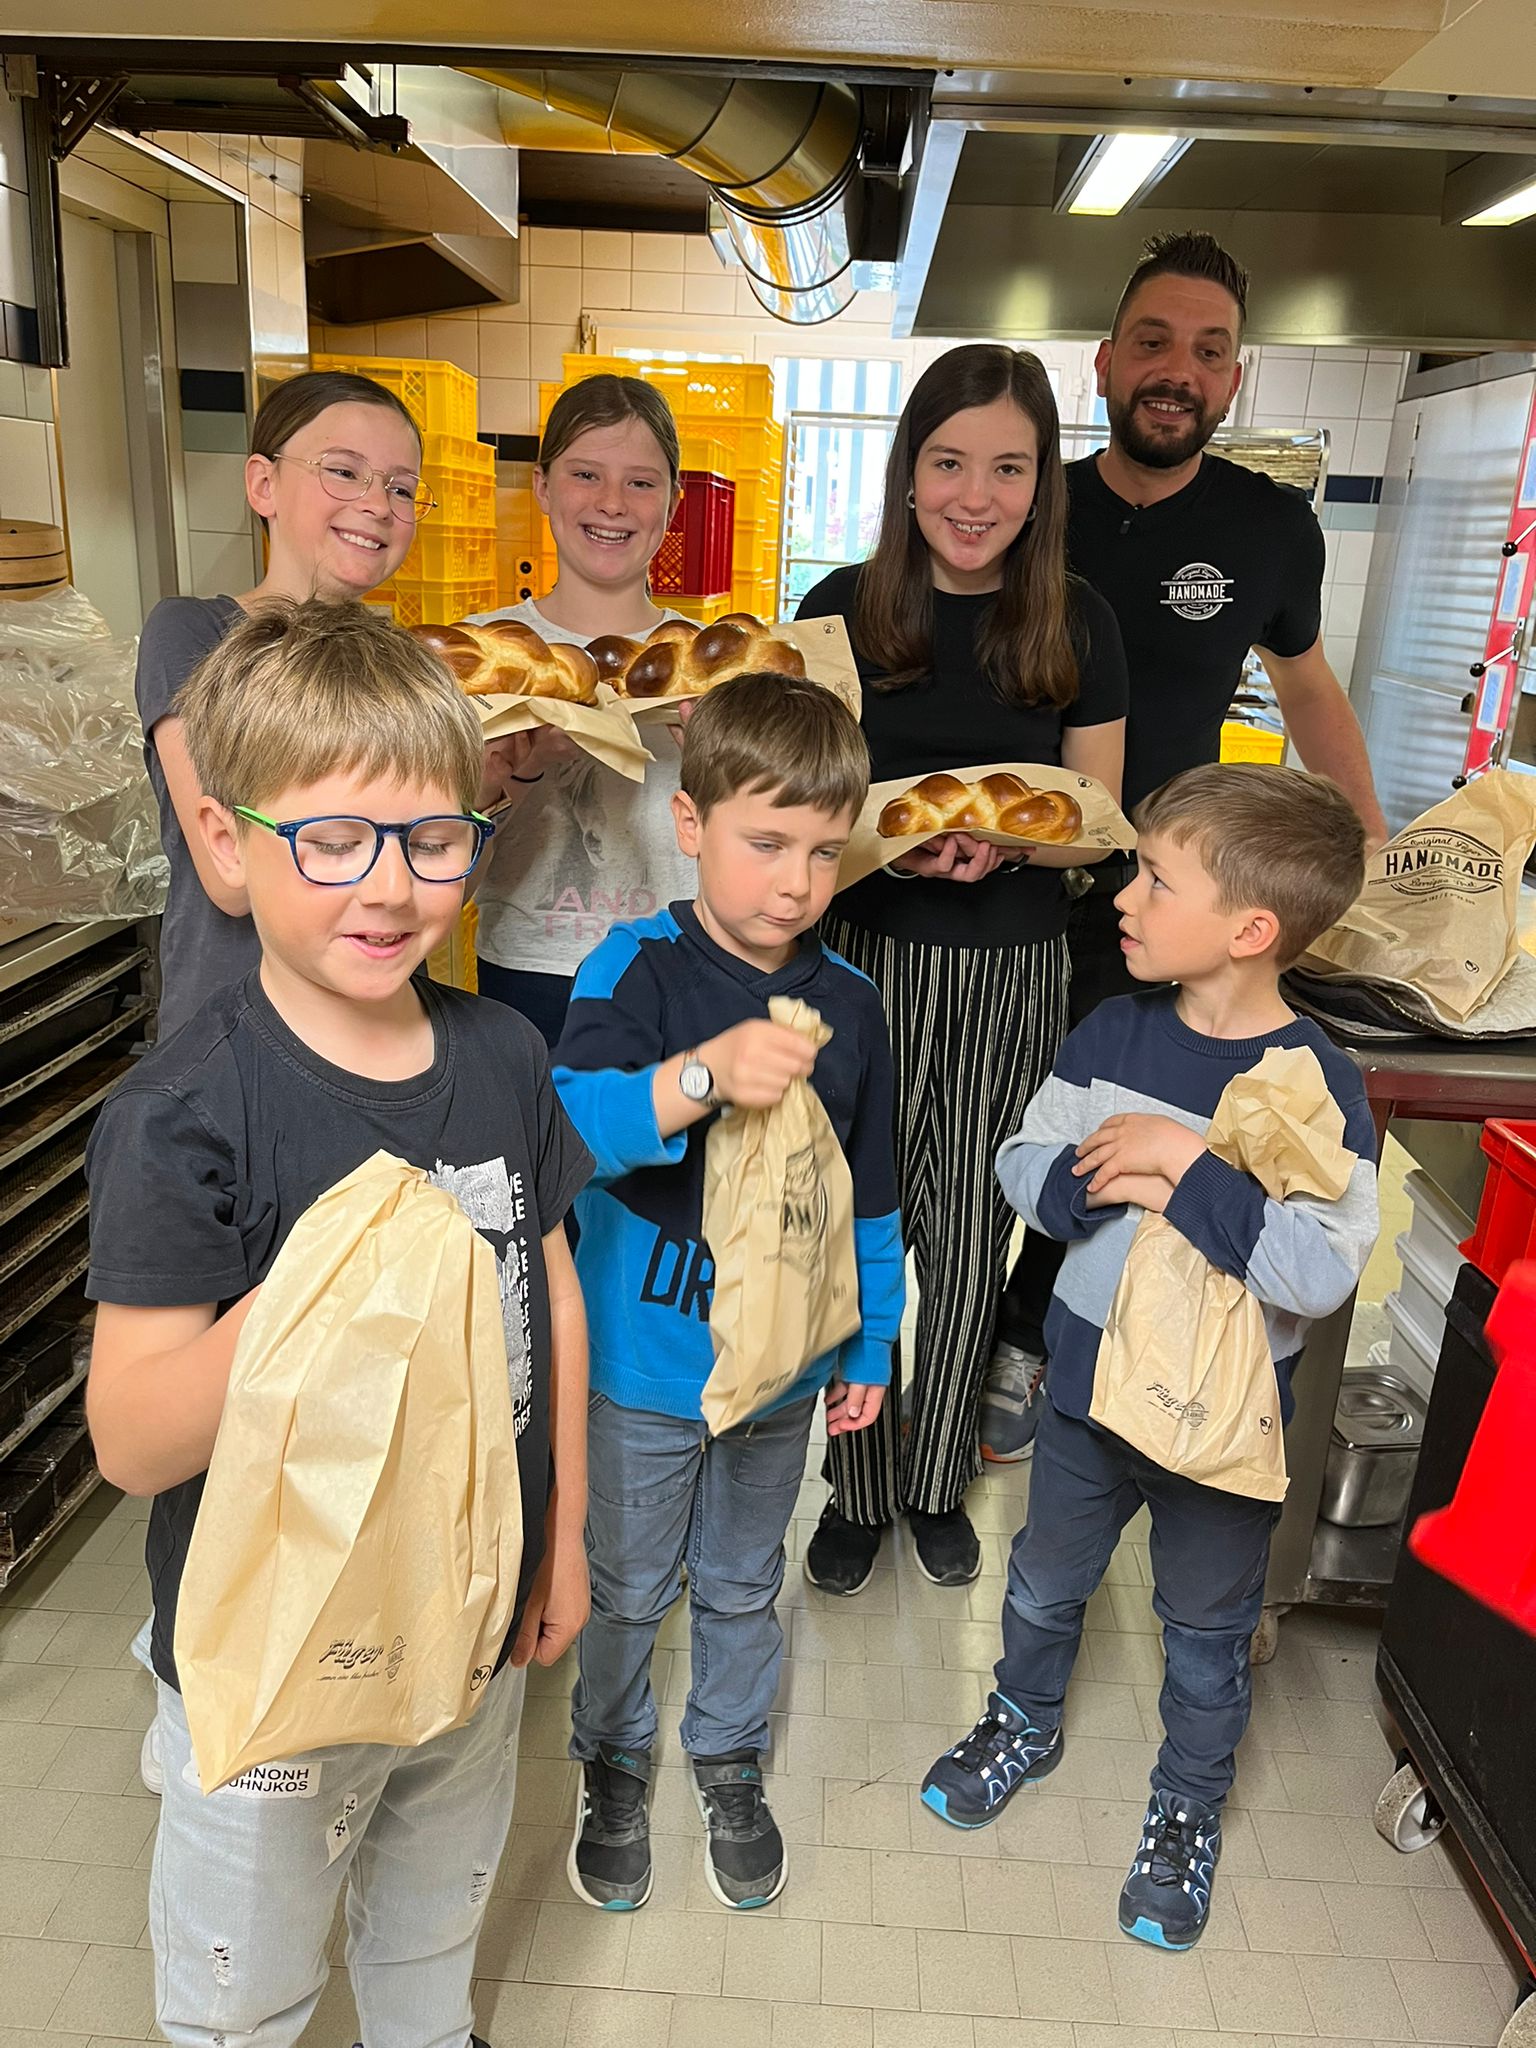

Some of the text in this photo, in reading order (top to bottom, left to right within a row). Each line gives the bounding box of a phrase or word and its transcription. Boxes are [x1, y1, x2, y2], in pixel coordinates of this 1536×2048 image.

[1168, 583, 1226, 600] HANDMADE
[1385, 848, 1504, 878] HANDMADE
[551, 886, 657, 916] AND
